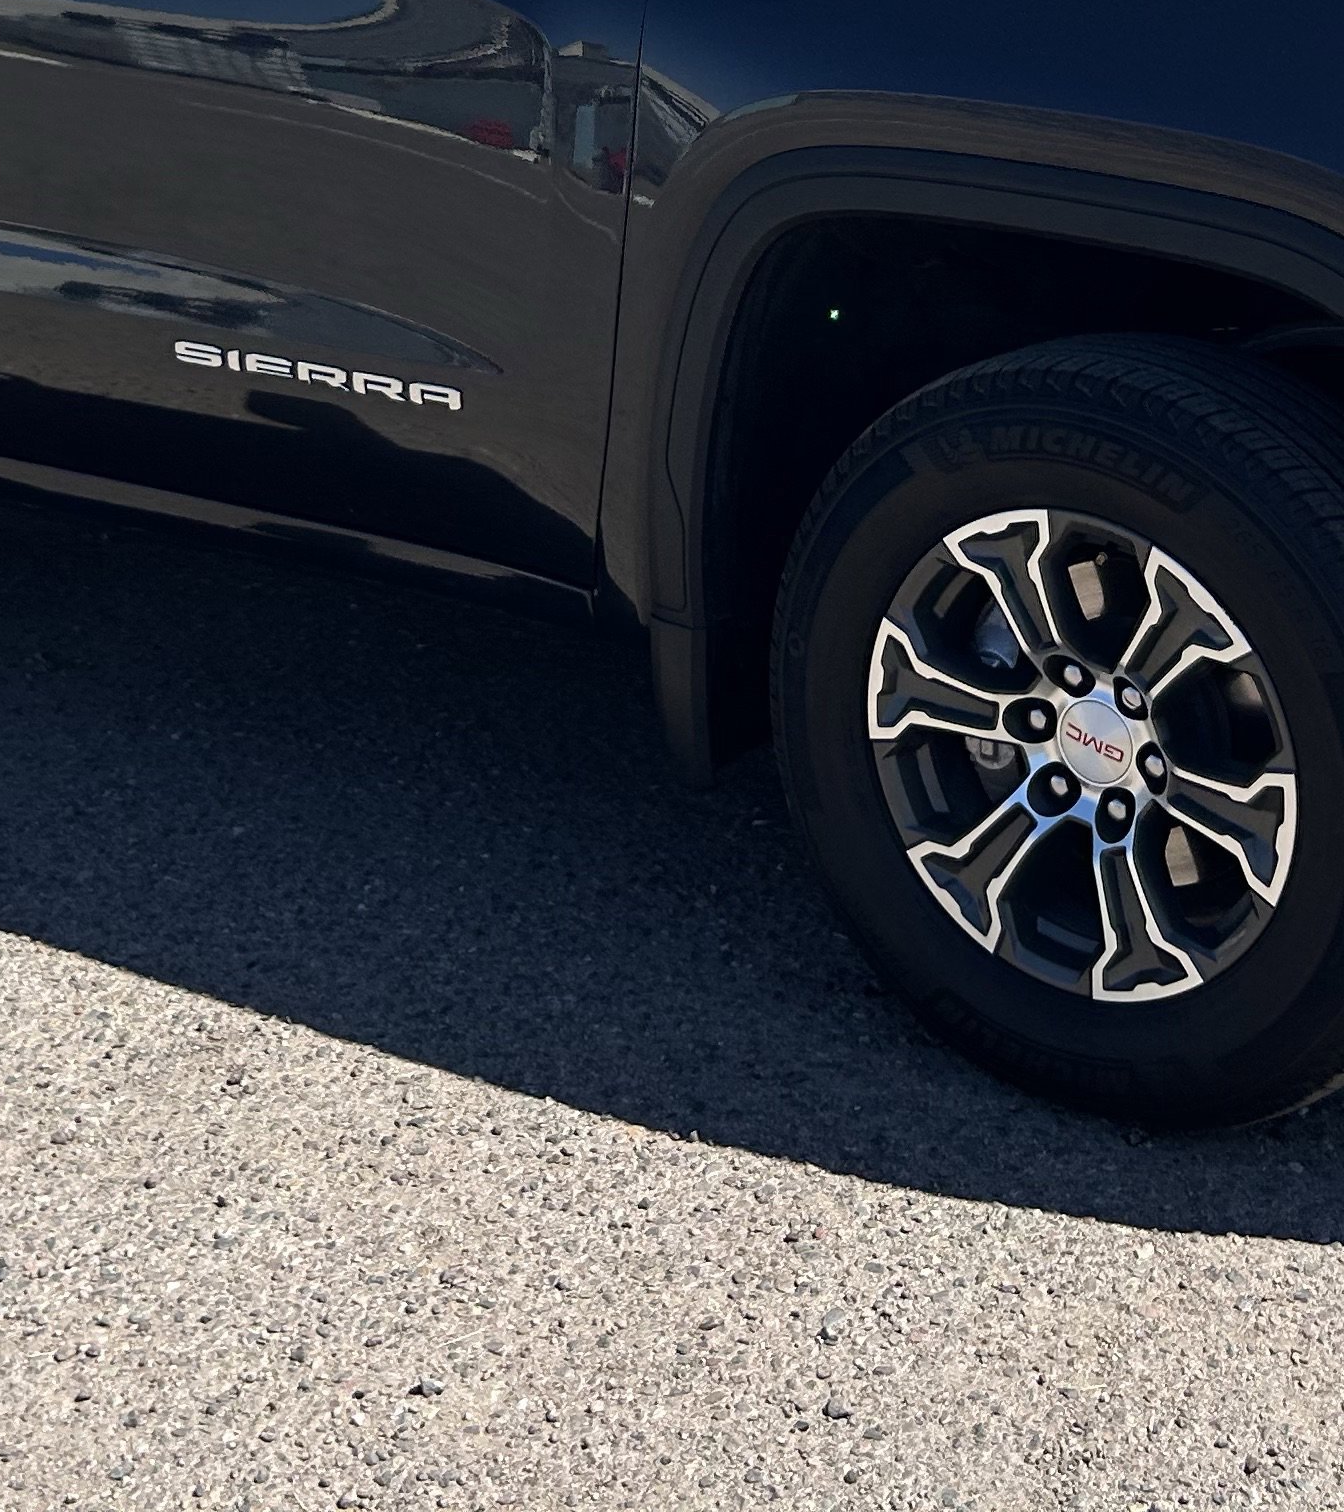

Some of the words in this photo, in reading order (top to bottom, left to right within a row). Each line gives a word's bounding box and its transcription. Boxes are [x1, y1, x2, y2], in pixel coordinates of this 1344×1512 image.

[174, 339, 464, 412] SIERRA
[990, 425, 1197, 505] MICHELIN
[1066, 722, 1124, 763] GMC
